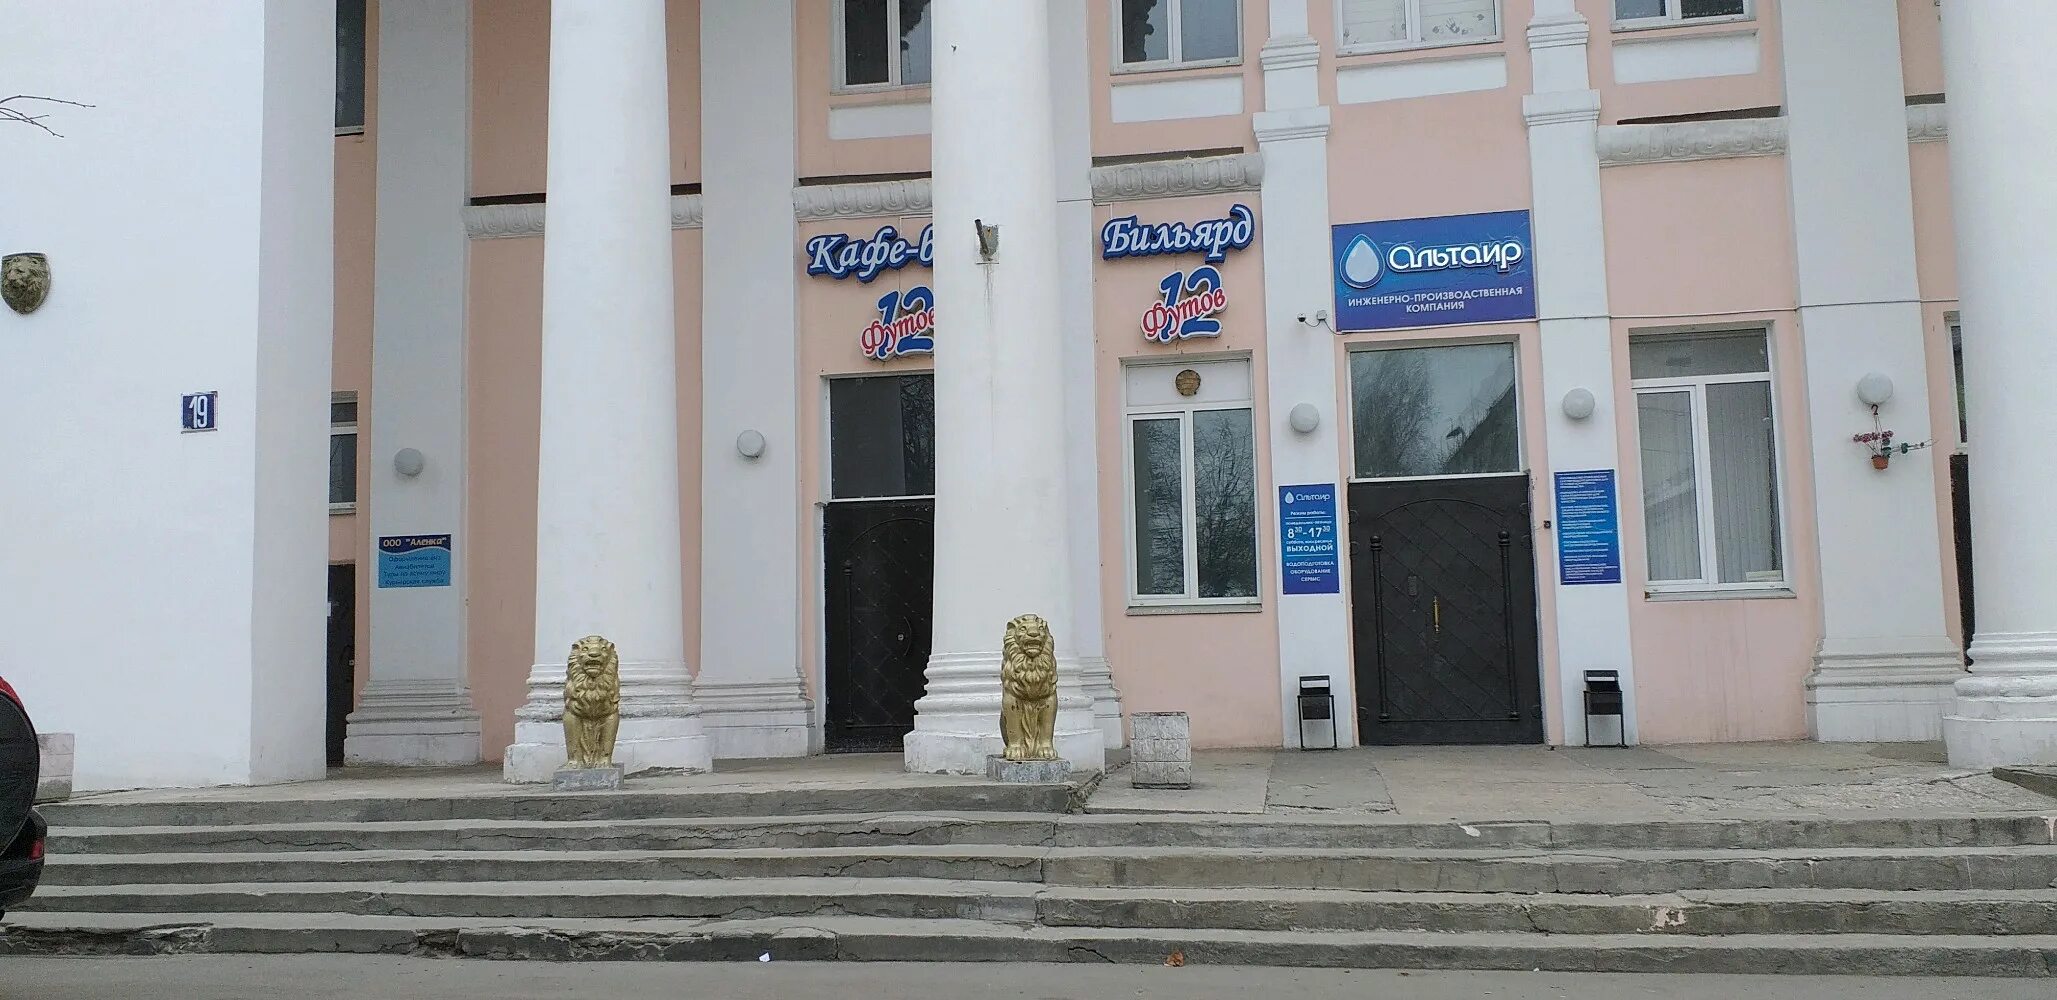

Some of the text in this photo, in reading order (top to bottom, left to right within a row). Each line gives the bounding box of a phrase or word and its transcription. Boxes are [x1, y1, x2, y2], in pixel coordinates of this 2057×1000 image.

[1102, 205, 1253, 260] Бильярд
[1141, 288, 1227, 338] Футов
[1158, 265, 1222, 343] 12
[1347, 286, 1524, 307] ИНЖЕНЕРНО-ПРОИЗВОДСТВЕННАЯ
[1406, 301, 1465, 313] КОМПАНИЯ
[876, 285, 934, 358] 12
[188, 395, 208, 428] 19
[383, 539, 402, 547] ООО
[1286, 542, 1333, 552] ВЫХОДНОЙ
